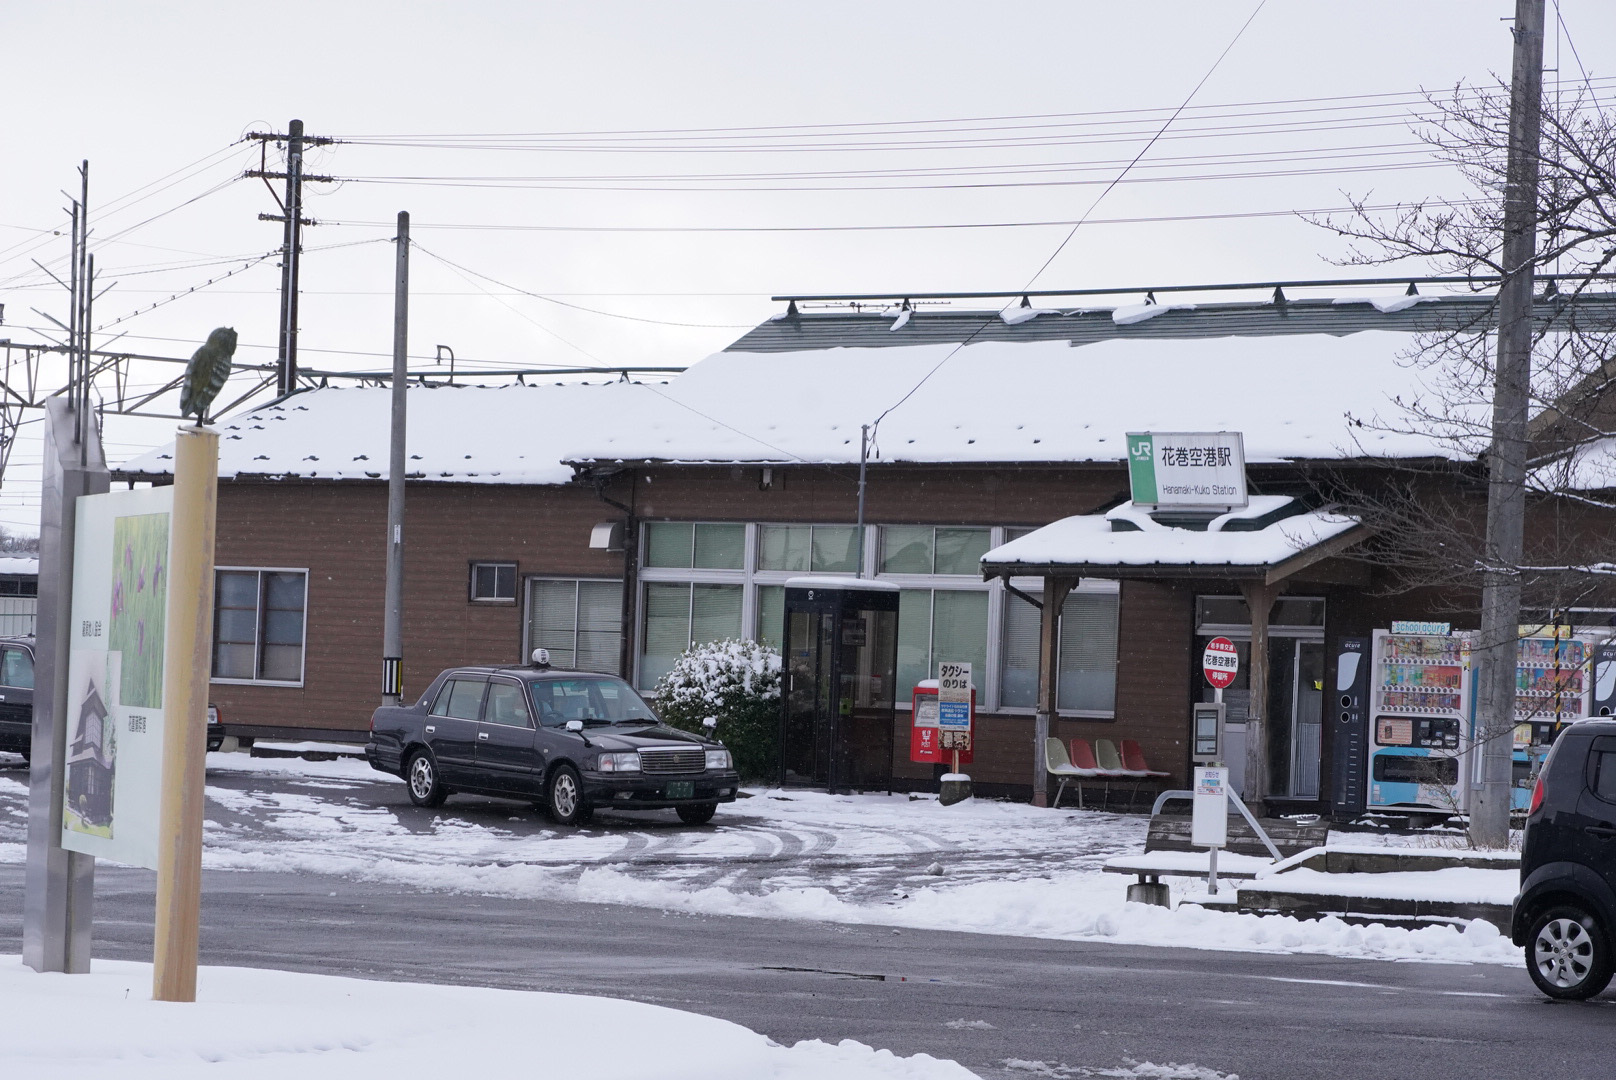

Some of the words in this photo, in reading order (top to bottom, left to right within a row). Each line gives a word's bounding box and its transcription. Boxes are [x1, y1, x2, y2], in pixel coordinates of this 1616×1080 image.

[1132, 442, 1151, 456] JR
[1161, 446, 1232, 467] 花巻空港駅
[1163, 485, 1211, 495] Hanamaki-Kuko
[1212, 485, 1238, 496] Station
[1205, 654, 1237, 668] 花巻空港駅
[941, 665, 969, 677] タクシー
[943, 679, 967, 689] のりば
